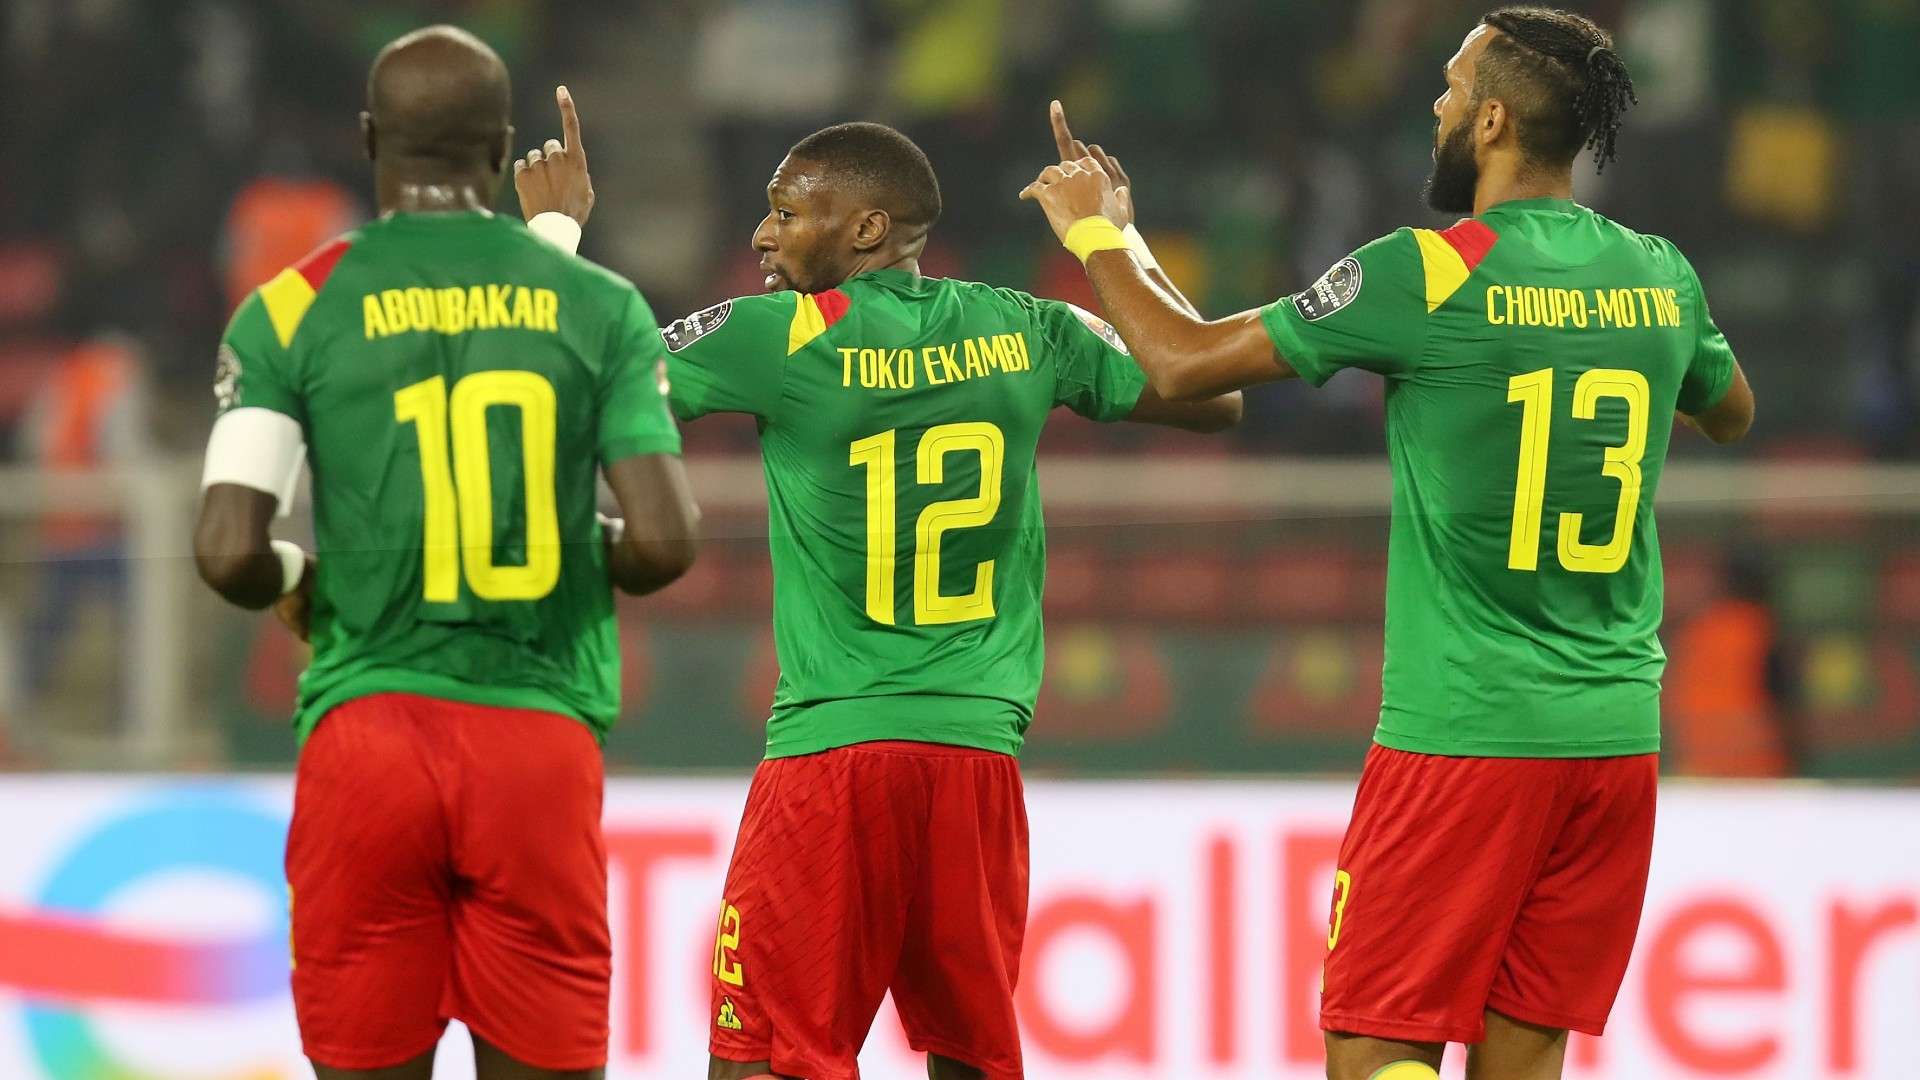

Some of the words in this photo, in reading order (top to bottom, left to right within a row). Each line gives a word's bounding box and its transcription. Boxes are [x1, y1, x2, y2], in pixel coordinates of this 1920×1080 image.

[363, 284, 559, 339] ABOUBAKAR
[1486, 285, 1680, 328] CHOUPO-MOTING
[837, 347, 914, 389] TOKO
[923, 332, 1030, 385] EKAMBI
[394, 369, 561, 603] 10
[1507, 367, 1650, 574] 13
[849, 421, 1006, 626] 12
[1327, 869, 1351, 951] 3
